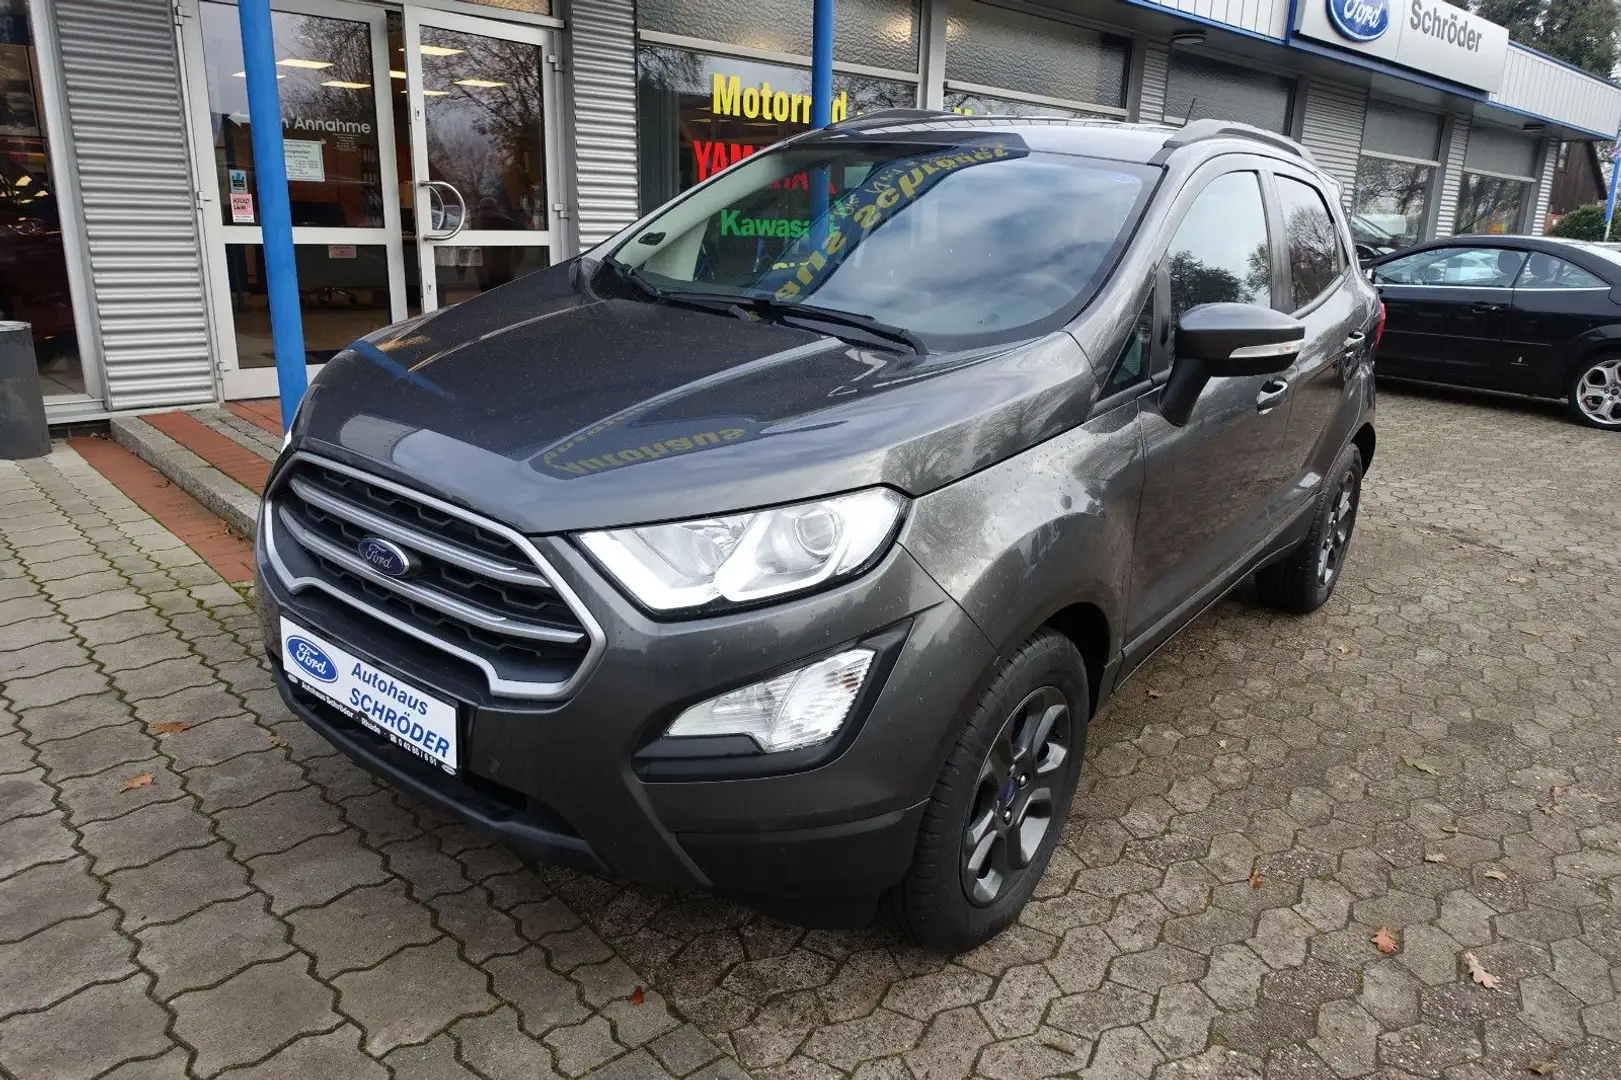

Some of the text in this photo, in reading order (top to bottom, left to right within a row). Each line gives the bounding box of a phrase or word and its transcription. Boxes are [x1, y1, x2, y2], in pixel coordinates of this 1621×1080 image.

[1410, 0, 1482, 52] Schröder
[713, 73, 848, 124] Motorrd
[294, 115, 372, 134] Annahme
[719, 208, 836, 239] Kawasi
[365, 543, 393, 569] Ford
[295, 642, 328, 675] Ford
[351, 662, 428, 716] Autohaus
[350, 687, 450, 758] SCHRÖDER
